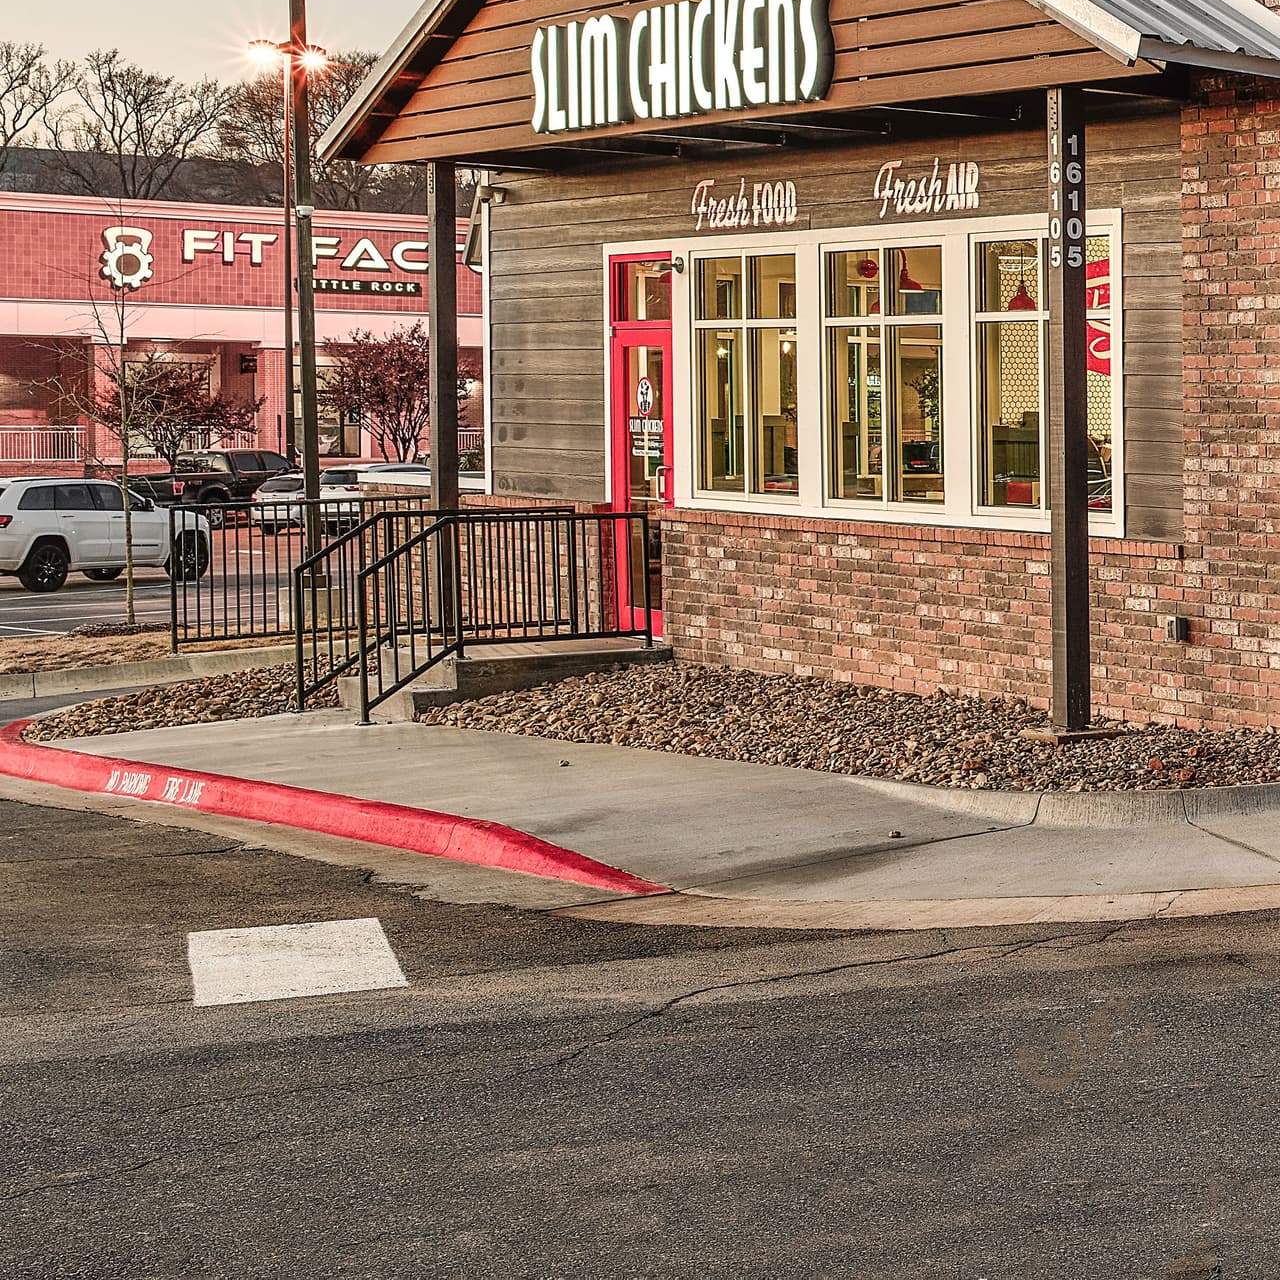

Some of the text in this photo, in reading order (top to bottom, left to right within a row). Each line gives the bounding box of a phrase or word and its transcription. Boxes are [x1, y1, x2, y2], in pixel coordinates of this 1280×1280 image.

[531, 14, 620, 134] SLIM
[691, 178, 798, 231] Fresh FOOD
[874, 157, 979, 218] Fresh AIR
[1066, 134, 1083, 267] 16105
[182, 229, 279, 266] FIT
[312, 279, 416, 292] ITTLE ROCK
[161, 777, 183, 802] FIRE
